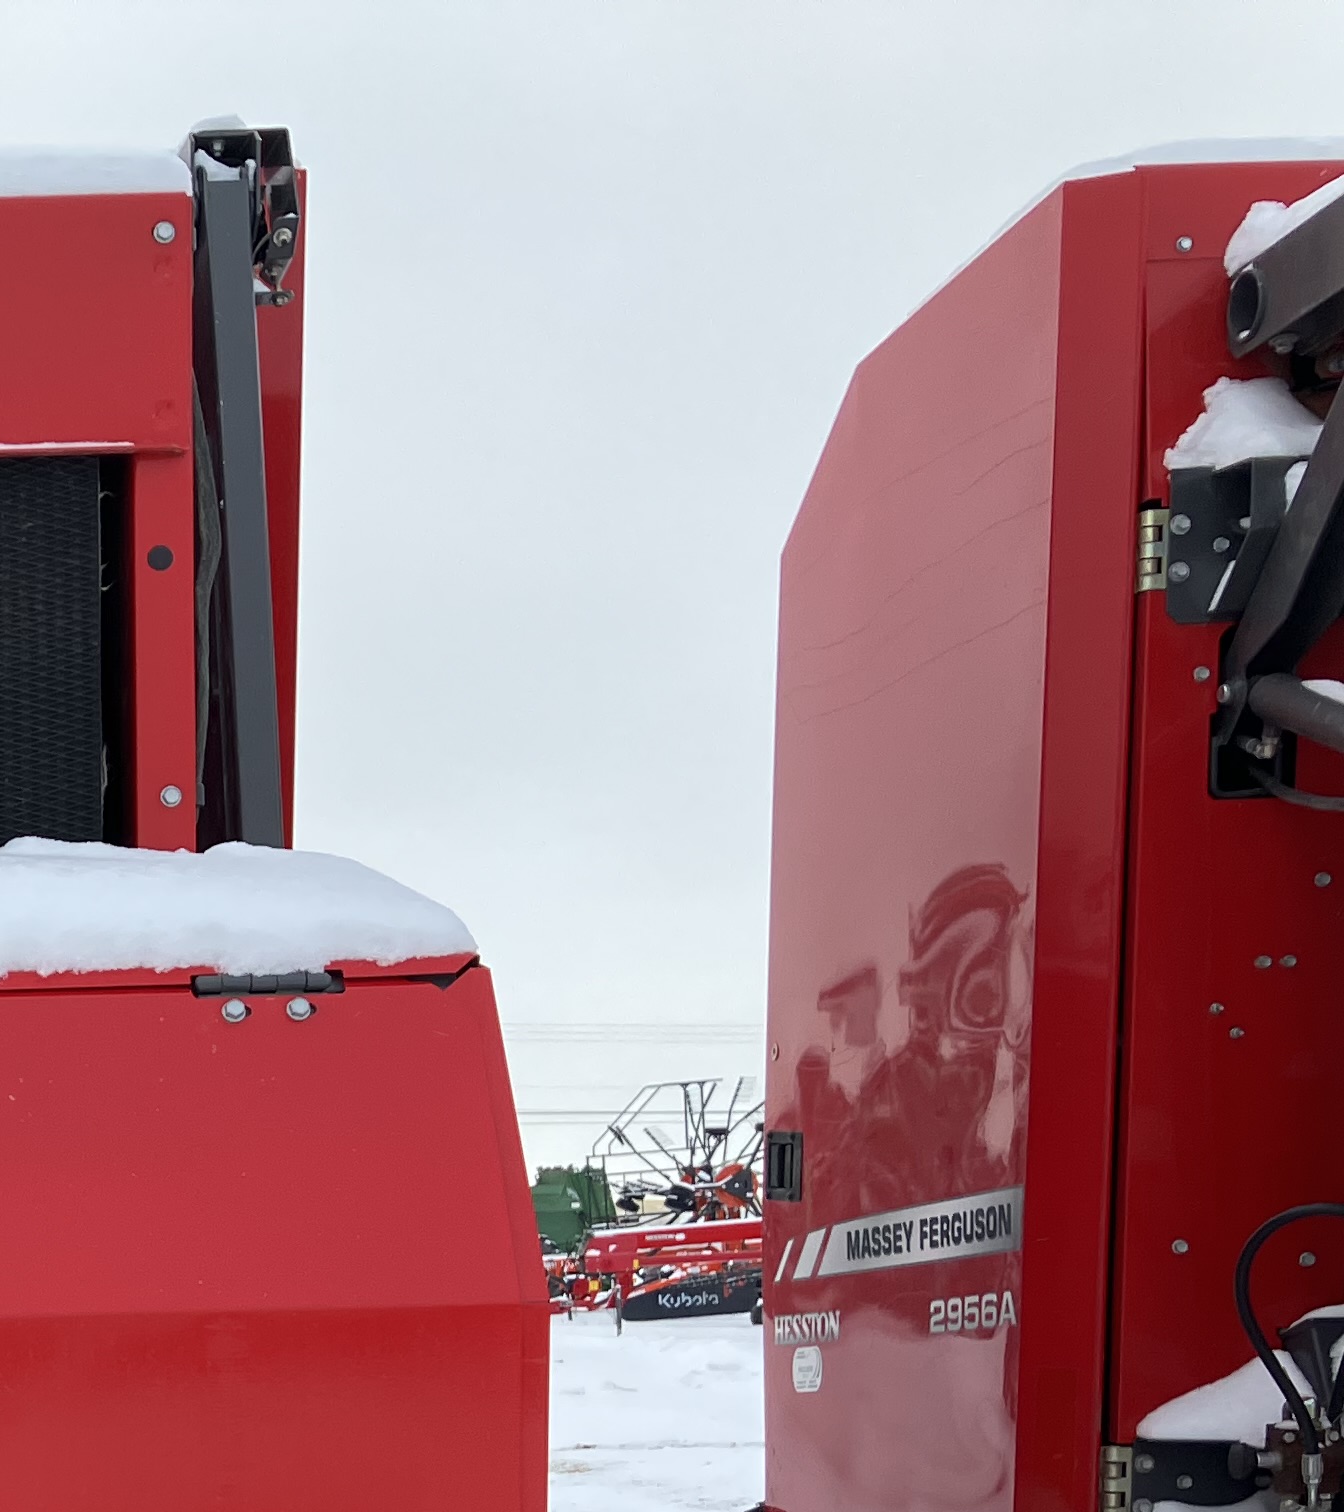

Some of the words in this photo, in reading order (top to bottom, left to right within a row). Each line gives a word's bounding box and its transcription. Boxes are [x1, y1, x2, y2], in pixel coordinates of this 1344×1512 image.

[846, 1220, 914, 1261] MASSEY
[919, 1203, 1012, 1250] FERGUSON
[658, 1290, 719, 1308] Kubota
[929, 1290, 1017, 1334] 2956A
[774, 1310, 841, 1346] HESSTON
